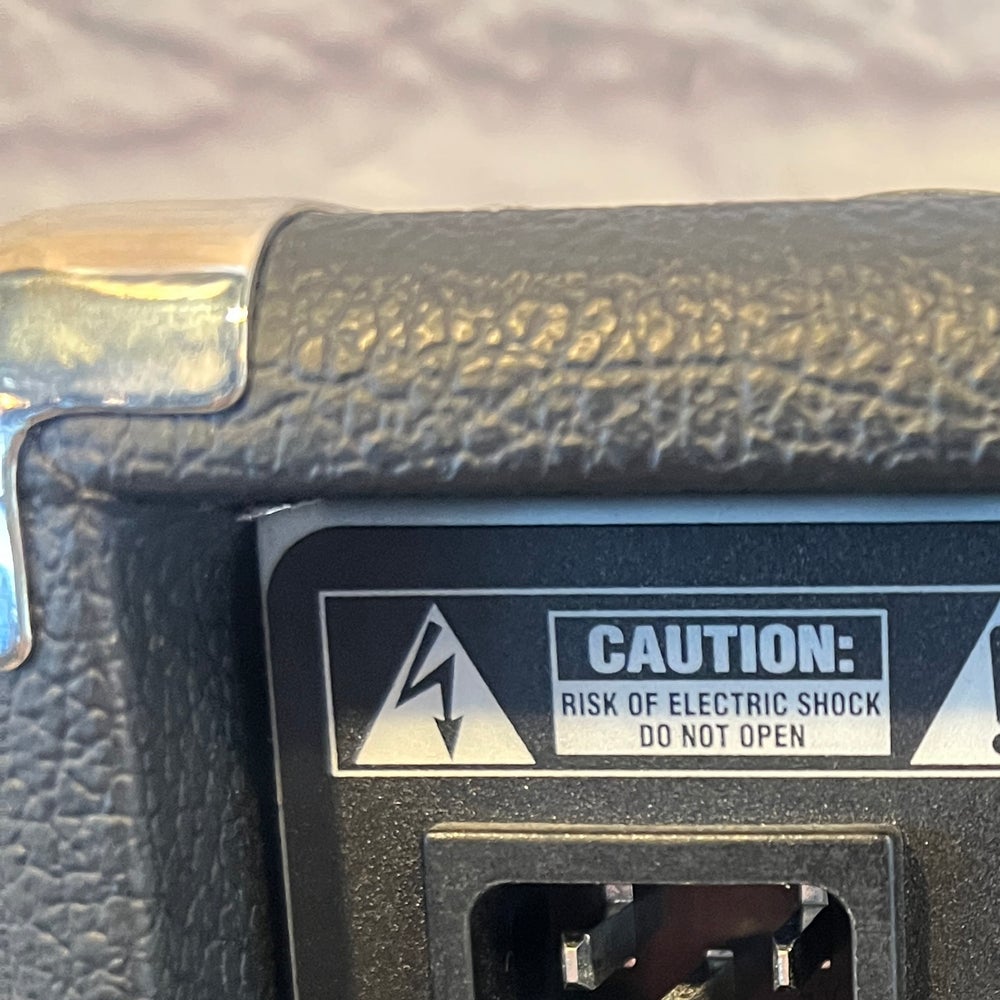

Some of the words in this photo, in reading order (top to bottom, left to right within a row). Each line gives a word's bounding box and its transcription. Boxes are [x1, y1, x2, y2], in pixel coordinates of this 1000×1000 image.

[588, 623, 855, 675] CAUTION:
[562, 693, 618, 716] RISK
[627, 693, 660, 716] OF
[668, 693, 788, 716] ELECTRIC
[797, 692, 881, 716] SHOCK
[639, 724, 673, 748] DO
[682, 724, 731, 748] NOT
[739, 724, 805, 748] OPEN
